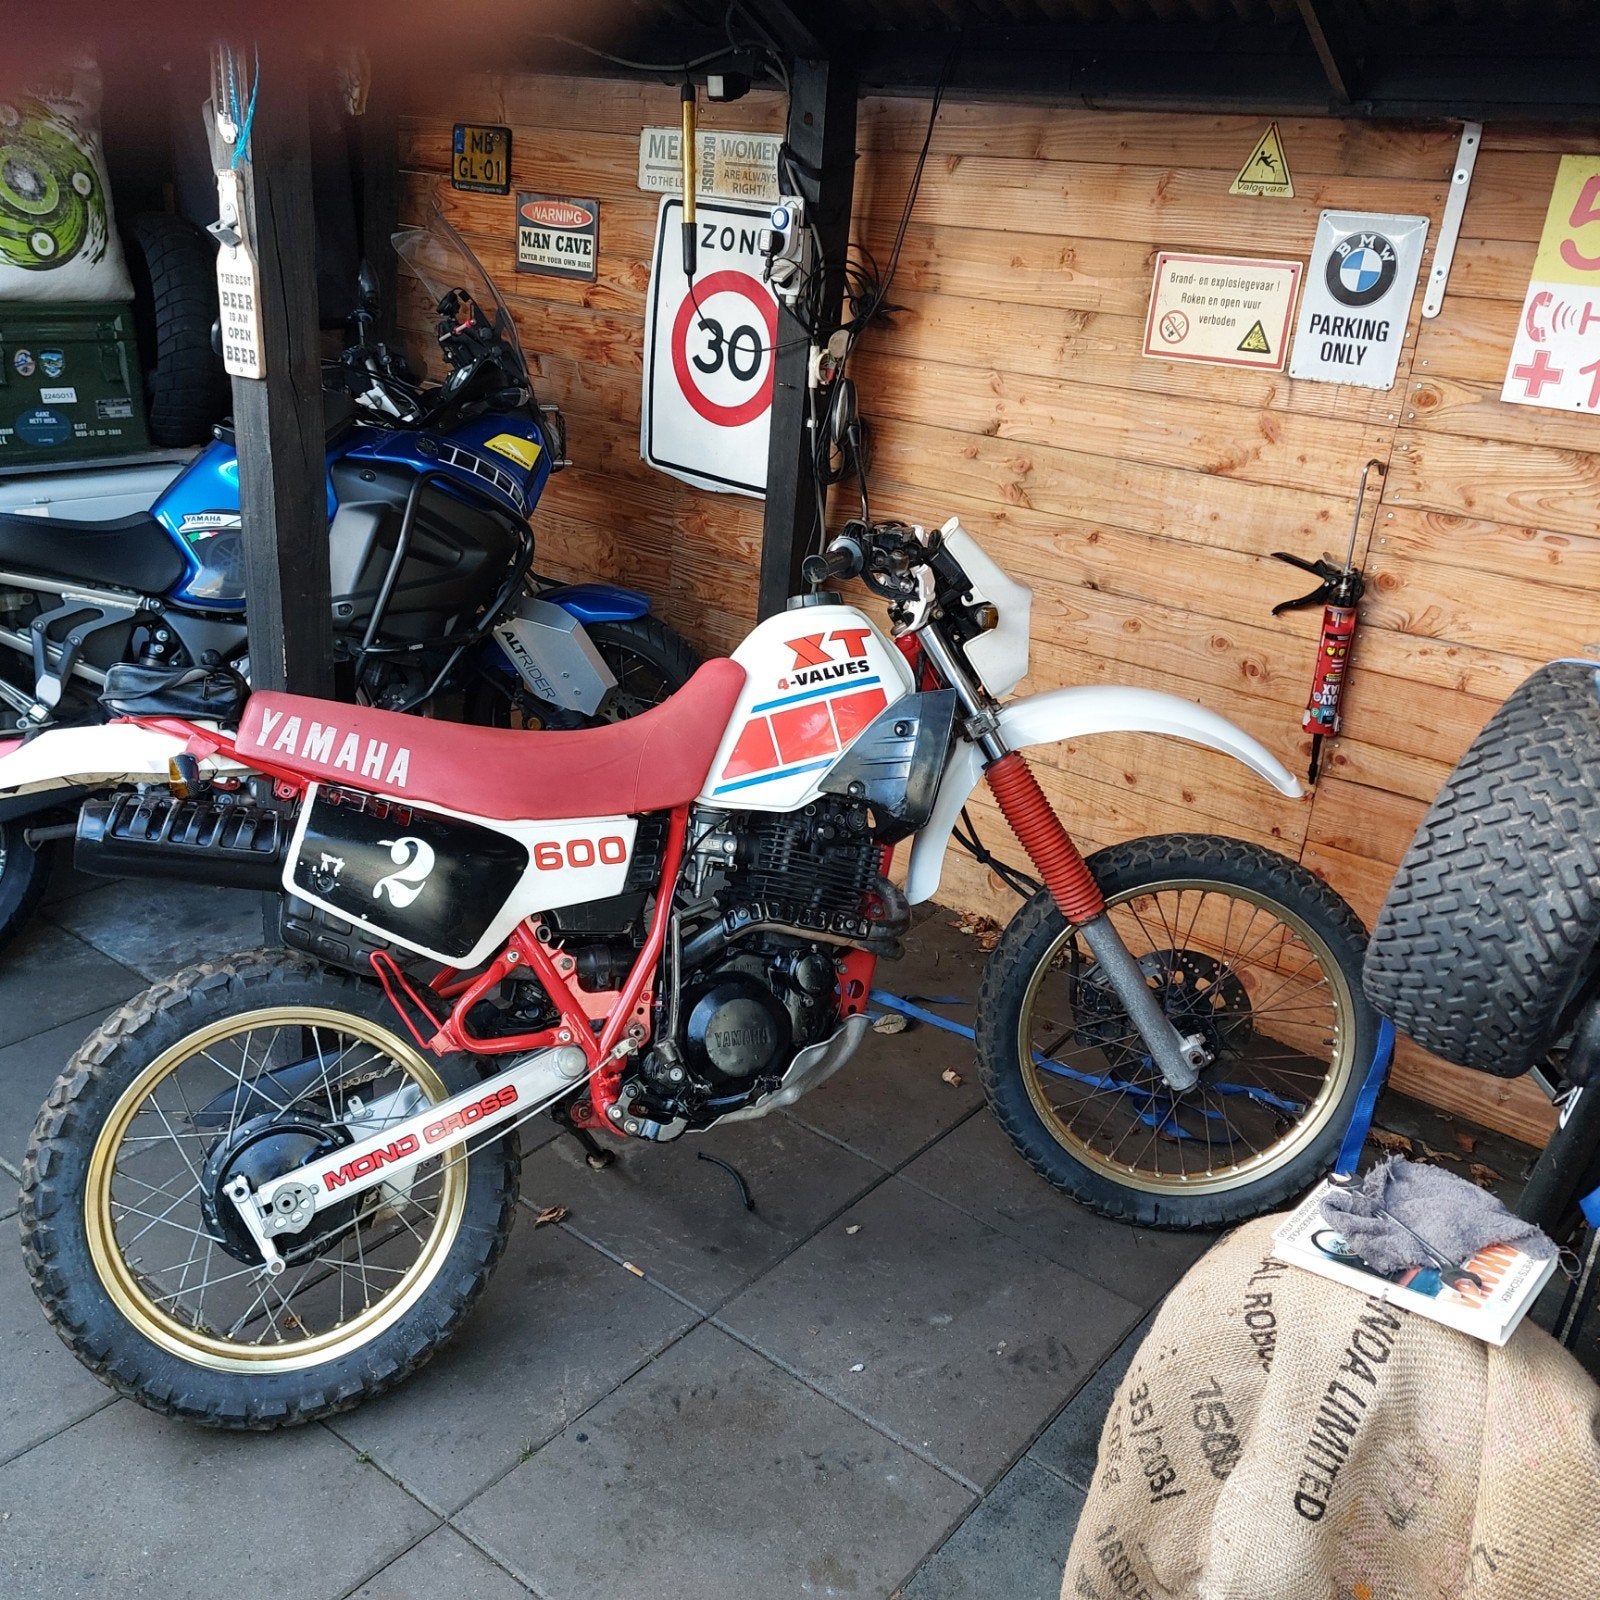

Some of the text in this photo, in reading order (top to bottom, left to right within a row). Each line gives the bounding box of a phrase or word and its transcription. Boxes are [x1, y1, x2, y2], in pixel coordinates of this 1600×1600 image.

[649, 134, 683, 161] ME
[701, 136, 716, 193] BECAUSE
[724, 170, 777, 184] ARE ALWAYS
[647, 175, 657, 185] TO
[659, 176, 674, 187] THE
[732, 183, 767, 196] RIGHT!
[1238, 182, 1289, 193] Valgevaar
[532, 206, 583, 224] WARNING
[521, 231, 592, 256] MAN CAVE
[701, 223, 768, 257] ZON
[1336, 234, 1395, 263] BMW
[520, 252, 592, 269] ENTER AT YOUR OWN RISK
[221, 273, 252, 287] THE BEST
[1170, 272, 1197, 286] Brand-
[1198, 276, 1209, 286] en
[222, 291, 253, 311] BEER
[1180, 292, 1262, 310] Roken en open vuur
[229, 312, 248, 323] IS AN
[1199, 313, 1236, 327] verboden
[1309, 313, 1390, 342] PARKING
[228, 327, 252, 342] OPEN
[226, 345, 257, 366] BEER
[692, 318, 762, 382] 30
[1320, 341, 1368, 366] ONLY
[784, 629, 872, 671] XT
[501, 631, 556, 699] ALTRIDER
[777, 659, 870, 691] 4-VALVES
[255, 707, 412, 789] YAMAHA
[534, 836, 627, 871] 600
[372, 837, 435, 908] 2
[714, 1029, 769, 1048] YAMAHA
[322, 1084, 519, 1192] MONO CROSS
[1294, 1380, 1367, 1522] LIMITED
